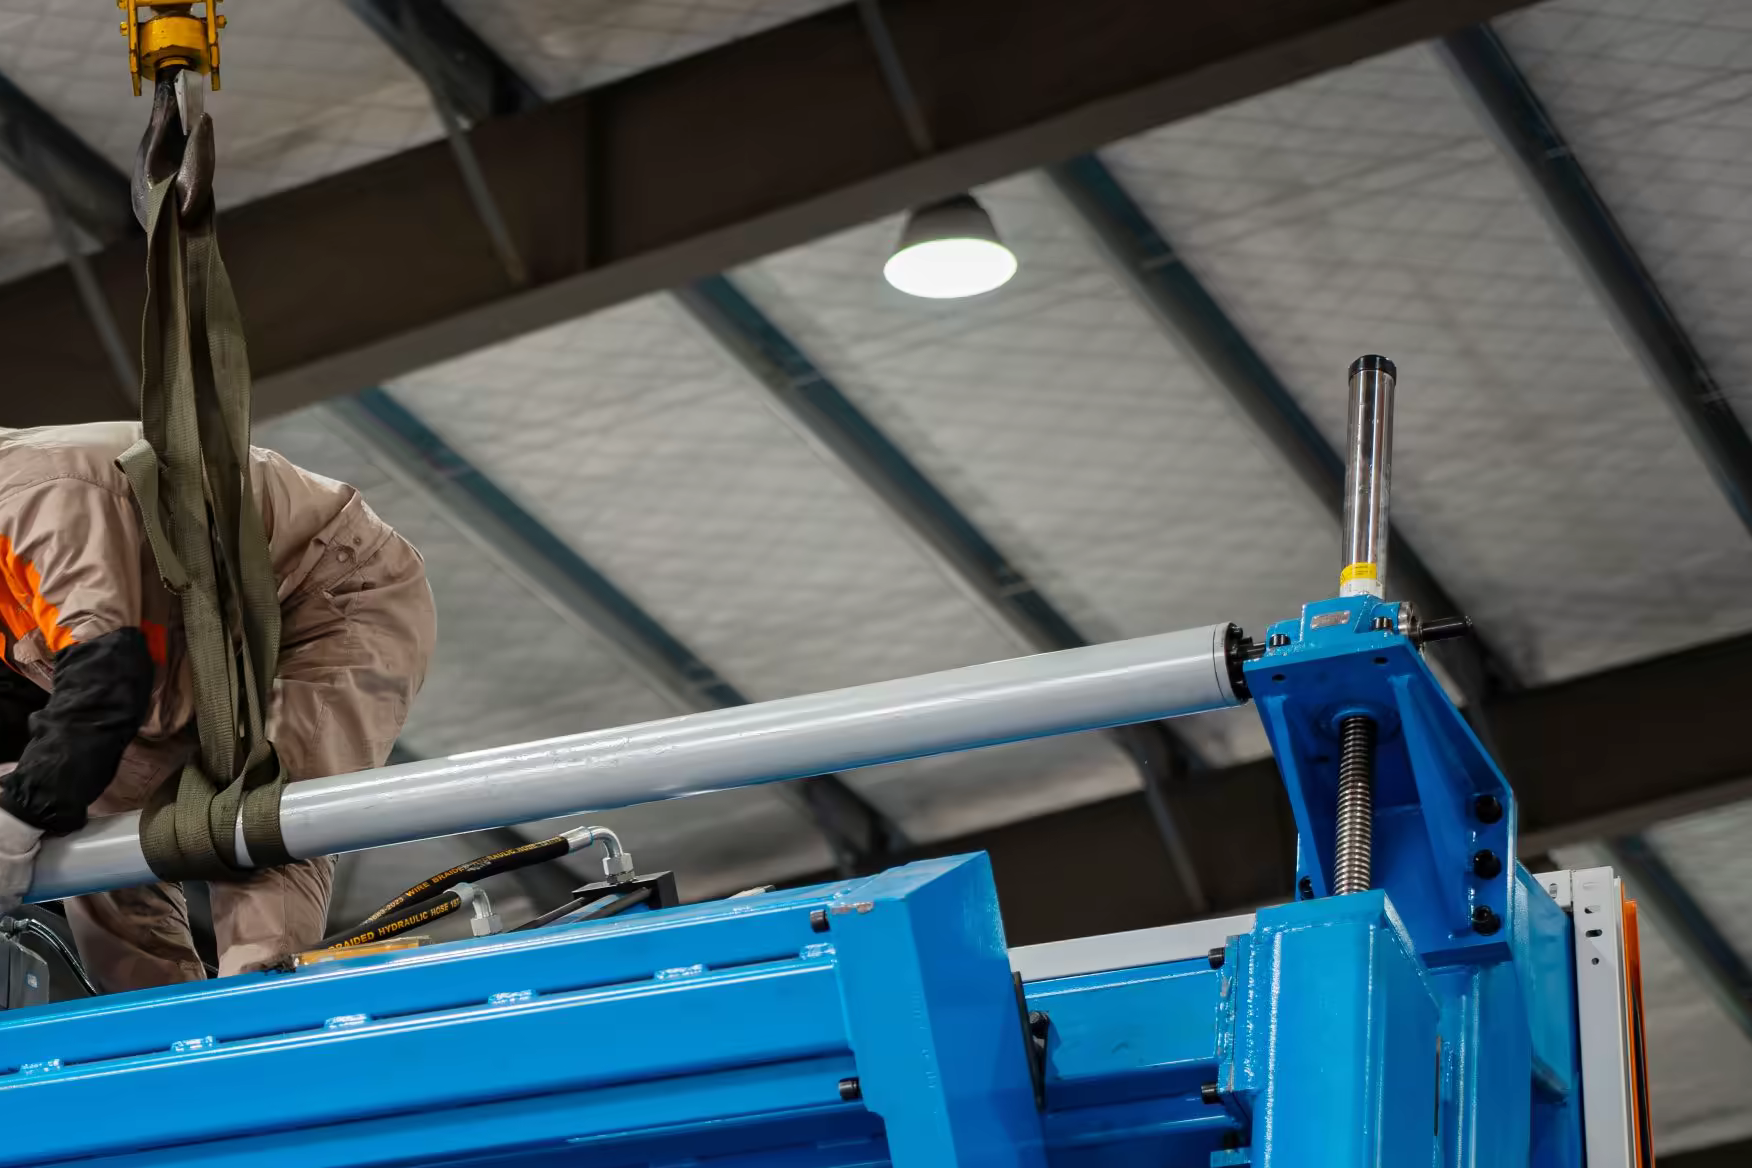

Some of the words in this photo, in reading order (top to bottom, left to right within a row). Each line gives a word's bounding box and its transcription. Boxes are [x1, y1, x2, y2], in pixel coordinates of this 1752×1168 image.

[407, 881, 430, 897] WIRE
[377, 911, 429, 936] HYDRAULIC
[430, 902, 449, 917] HOSE
